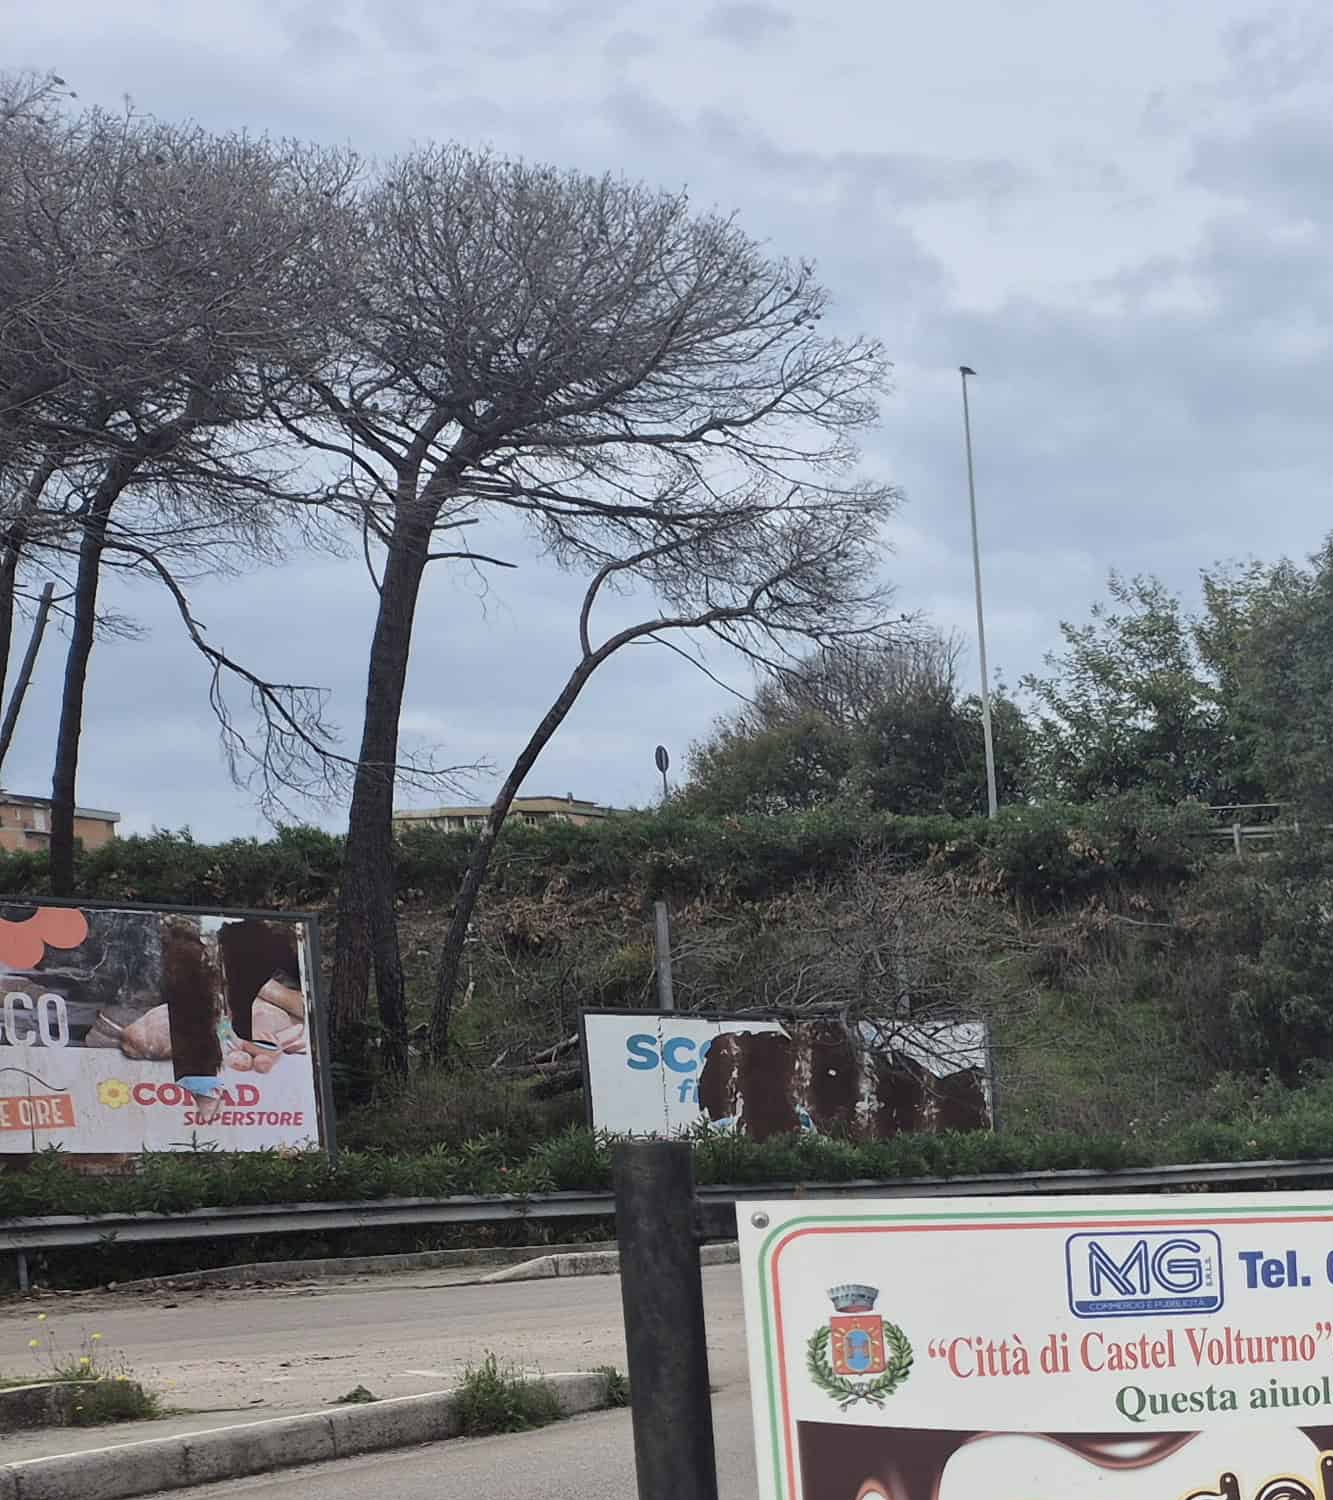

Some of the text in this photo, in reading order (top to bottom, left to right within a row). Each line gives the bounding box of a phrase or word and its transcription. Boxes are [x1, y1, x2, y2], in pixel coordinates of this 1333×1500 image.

[19, 1096, 65, 1127] ORE
[1088, 1238, 1203, 1296] MG
[1239, 1250, 1311, 1289] Tel.
[1040, 1332, 1071, 1375] di
[1080, 1328, 1177, 1372] Castel
[1115, 1383, 1239, 1422] Questa
